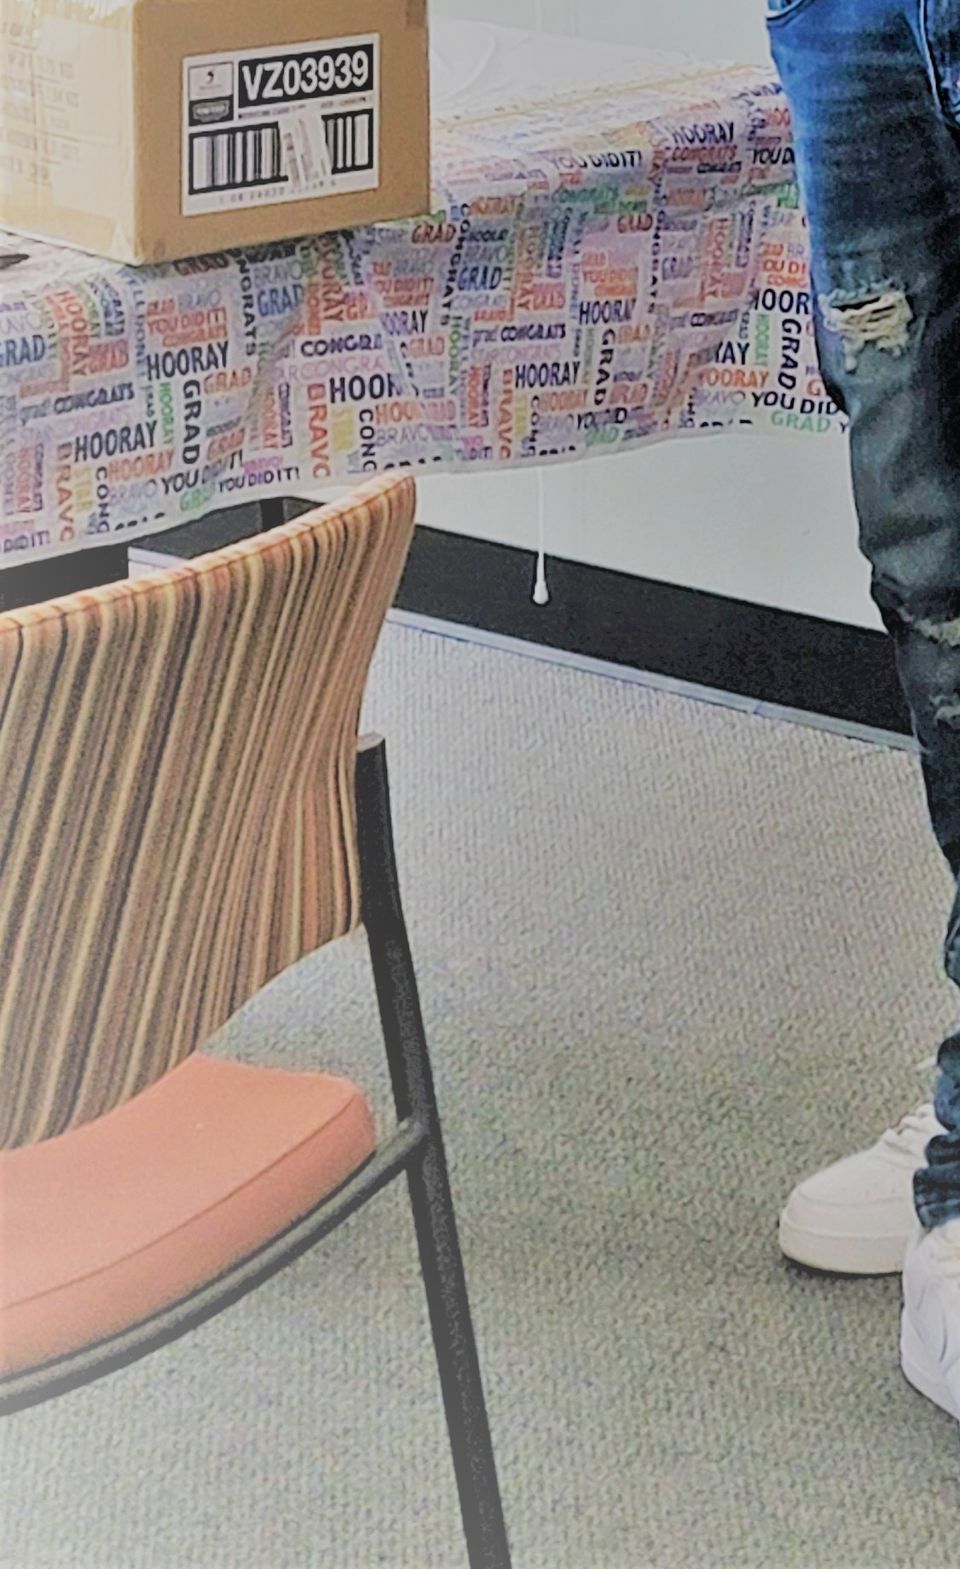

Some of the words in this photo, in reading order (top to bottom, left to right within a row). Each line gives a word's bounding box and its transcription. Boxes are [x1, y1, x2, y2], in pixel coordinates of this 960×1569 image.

[241, 49, 370, 102] VZ03939
[671, 121, 734, 145] HOORAY
[752, 148, 780, 165] YOU
[412, 222, 457, 244] GRAD
[173, 252, 231, 276] GRAD
[457, 265, 503, 291] GRAD
[258, 284, 303, 318] GRAD
[147, 315, 179, 336] YOU
[500, 323, 568, 343] CONGRATS
[0, 334, 46, 367] RAD
[146, 340, 229, 382] HOORAY
[448, 315, 463, 395] HOORAY
[778, 318, 802, 390] GRAD
[204, 366, 252, 394] GRAD
[515, 360, 581, 389] HOORAY
[594, 328, 616, 406] GRAD
[53, 382, 135, 414] CONGRATS
[751, 391, 796, 411] YOU
[800, 398, 840, 416] DID
[159, 383, 174, 445] HOORAY
[182, 379, 201, 465] GRAD
[770, 411, 832, 434] GRAD
[73, 419, 158, 464] HOORAY
[108, 448, 176, 483] HOORAY
[219, 473, 246, 493] YOU
[248, 468, 275, 487] DID
[277, 466, 300, 482] IT!
[161, 469, 199, 495] YOU
